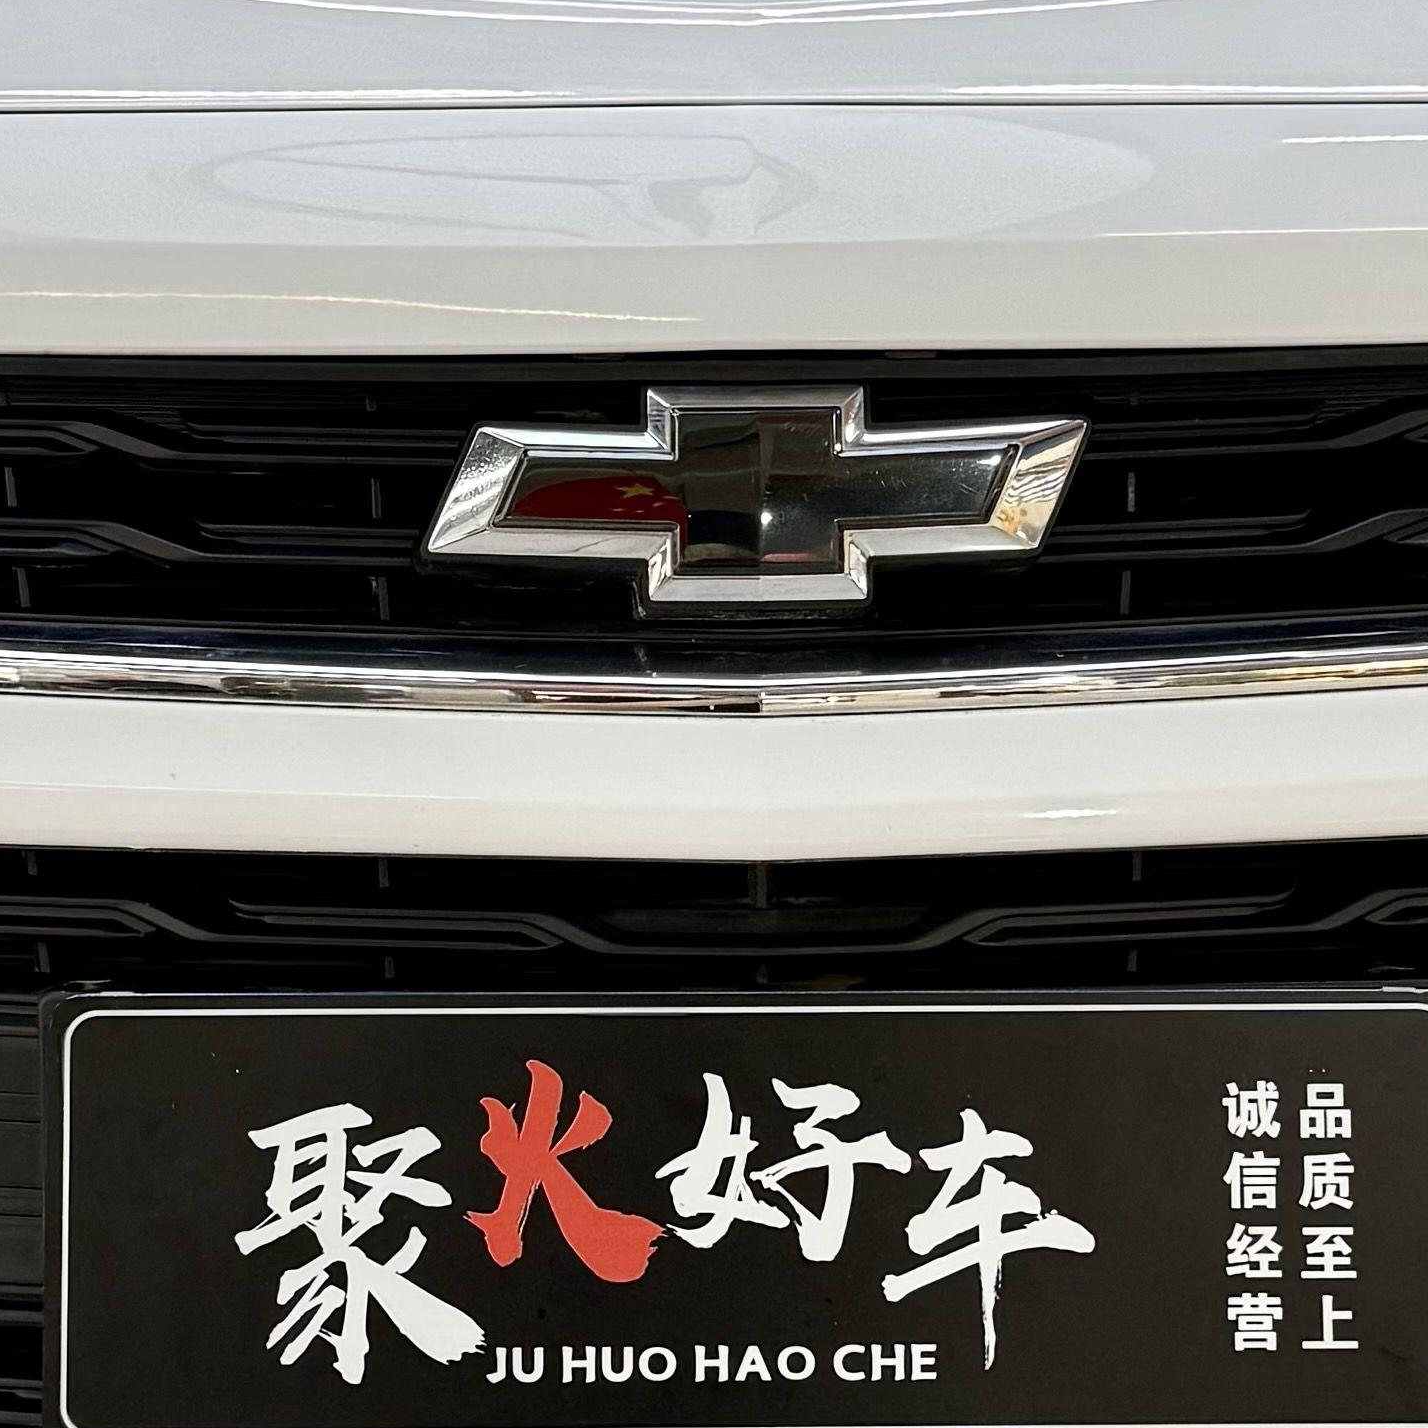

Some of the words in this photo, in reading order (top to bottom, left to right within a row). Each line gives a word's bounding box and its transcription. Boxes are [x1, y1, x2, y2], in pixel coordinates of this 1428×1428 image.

[235, 1060, 1095, 1384] 聚火好车
[1222, 1080, 1283, 1351] 诚信经营
[1299, 1084, 1358, 1349] 品质至上
[486, 1347, 544, 1383] JU
[562, 1346, 676, 1383] HUO
[695, 1345, 815, 1382] HAO
[833, 1344, 937, 1381] CHE
